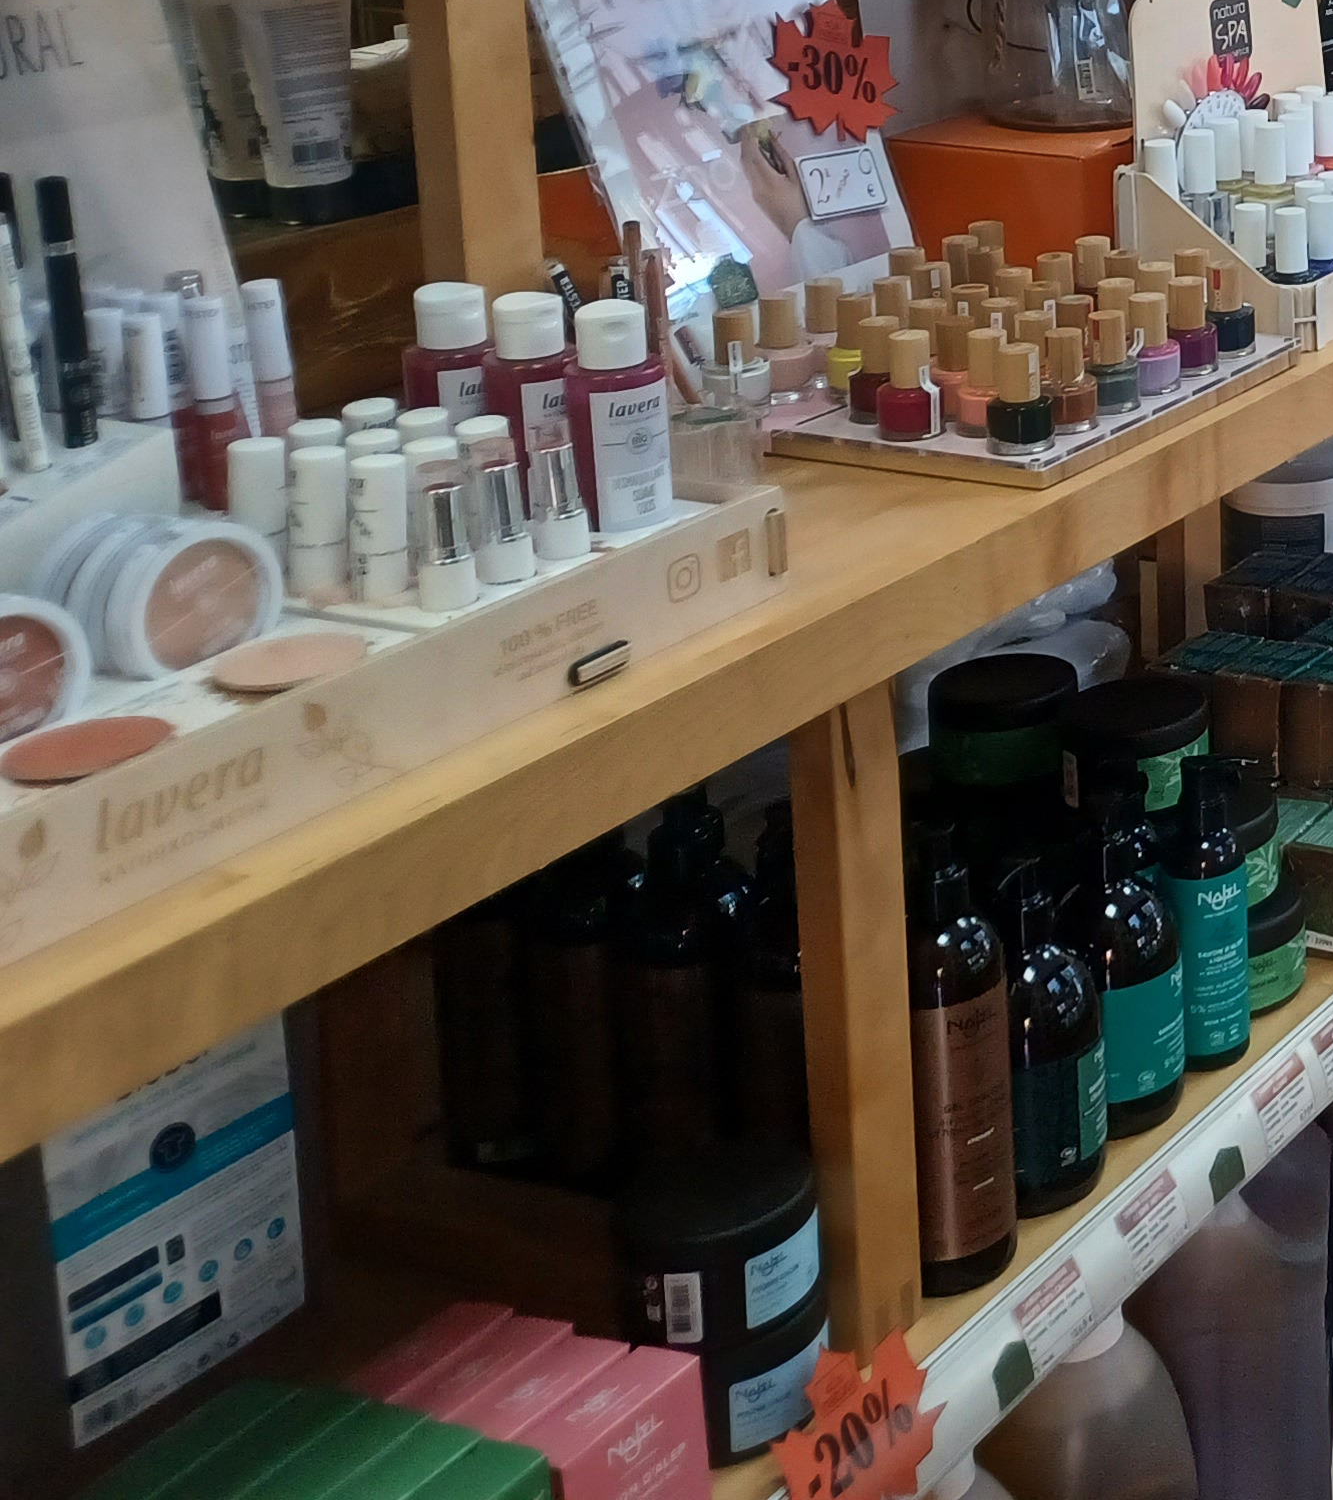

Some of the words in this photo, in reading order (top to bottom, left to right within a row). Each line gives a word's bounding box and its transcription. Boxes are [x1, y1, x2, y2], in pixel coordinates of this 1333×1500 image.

[1213, 2, 1246, 21] natura
[1215, 19, 1248, 50] SPA
[787, 44, 877, 104] -30%
[608, 394, 661, 419] lavera
[95, 745, 266, 855] lavera
[808, 1377, 914, 1498] -20%
